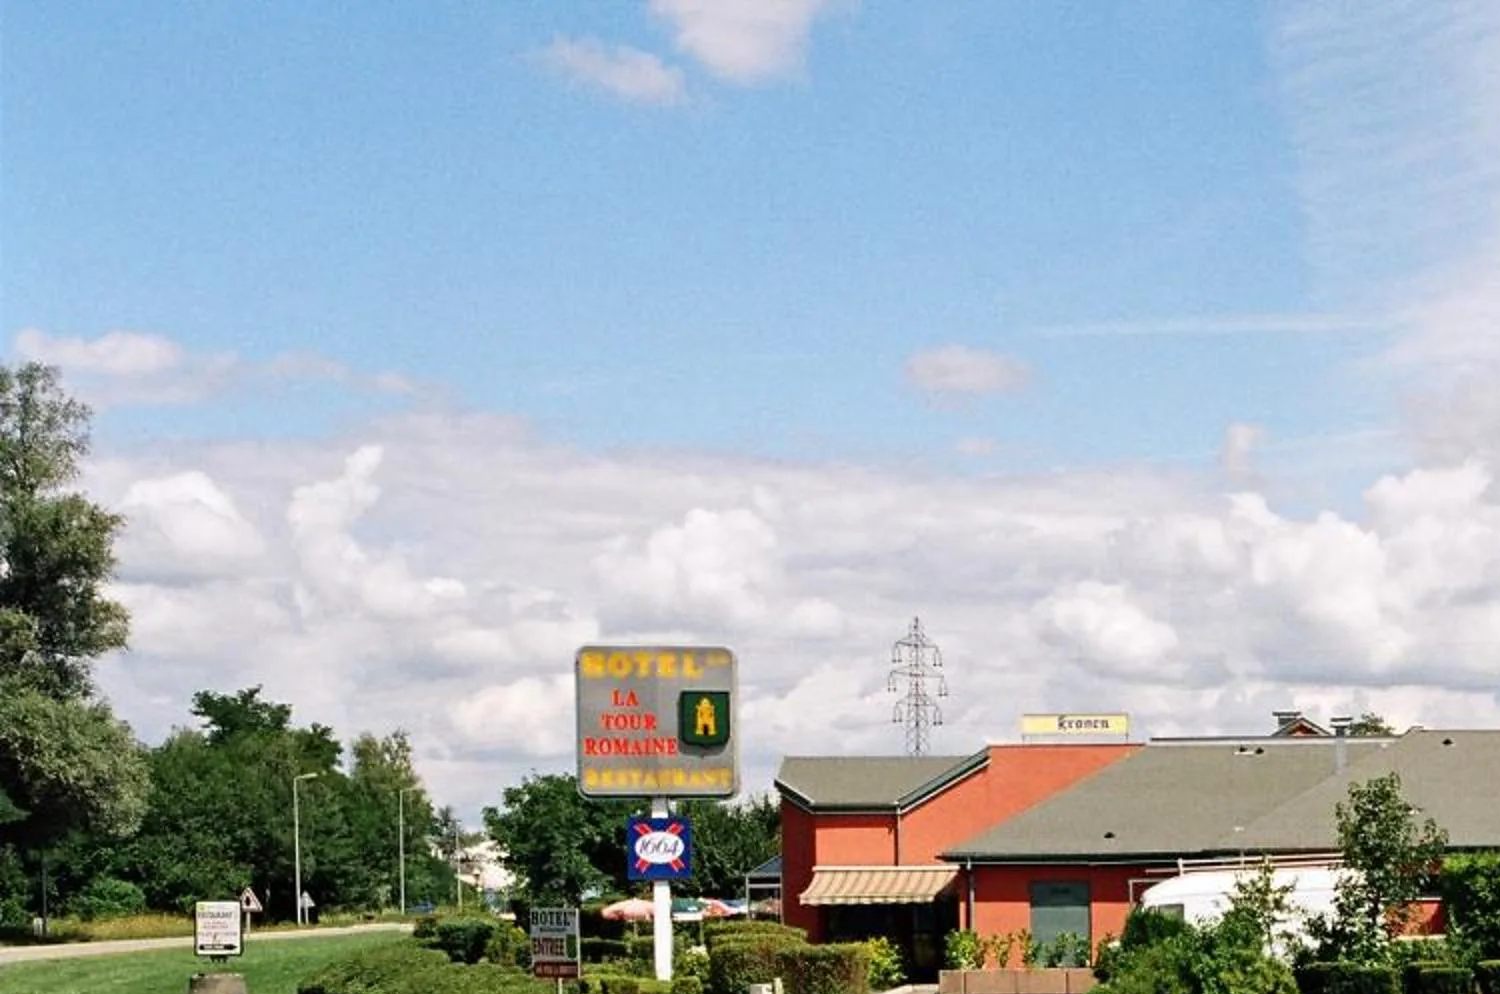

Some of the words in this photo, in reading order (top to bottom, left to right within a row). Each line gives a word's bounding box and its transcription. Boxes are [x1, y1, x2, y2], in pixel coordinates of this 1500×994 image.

[581, 651, 704, 679] HOTEL
[611, 689, 639, 707] LA
[601, 713, 657, 731] TOUR
[584, 738, 678, 756] ROMAINE
[585, 767, 732, 788] RESTAURANT
[531, 911, 571, 927] HOTEL
